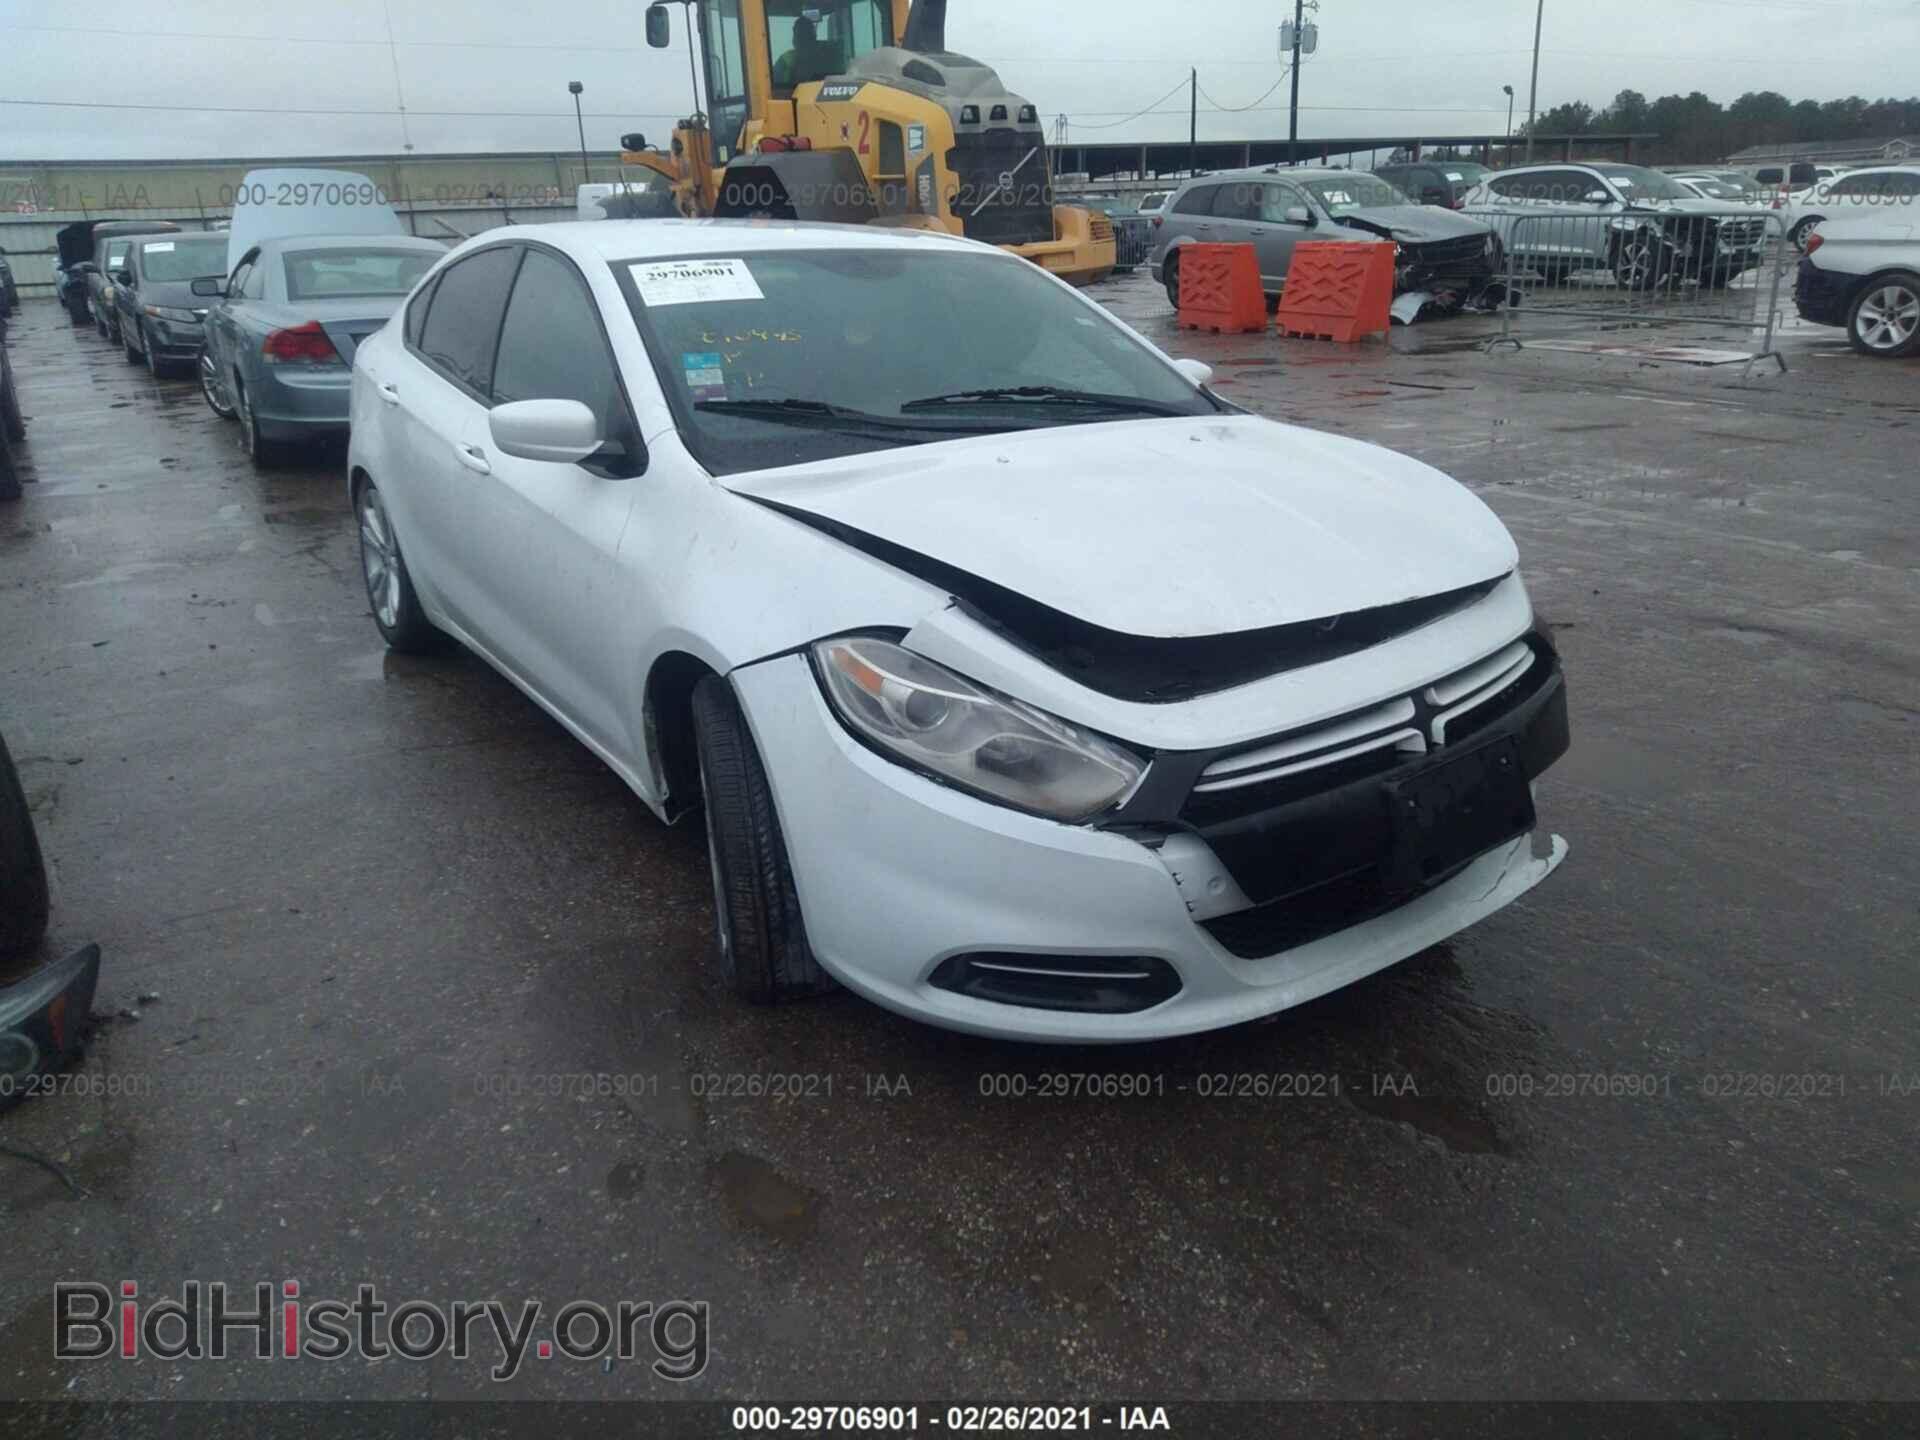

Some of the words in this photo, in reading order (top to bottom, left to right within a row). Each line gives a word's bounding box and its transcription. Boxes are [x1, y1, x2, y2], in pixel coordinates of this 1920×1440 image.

[823, 86, 858, 96] VOLVO
[858, 110, 870, 154] 2
[647, 268, 735, 281] 29706901
